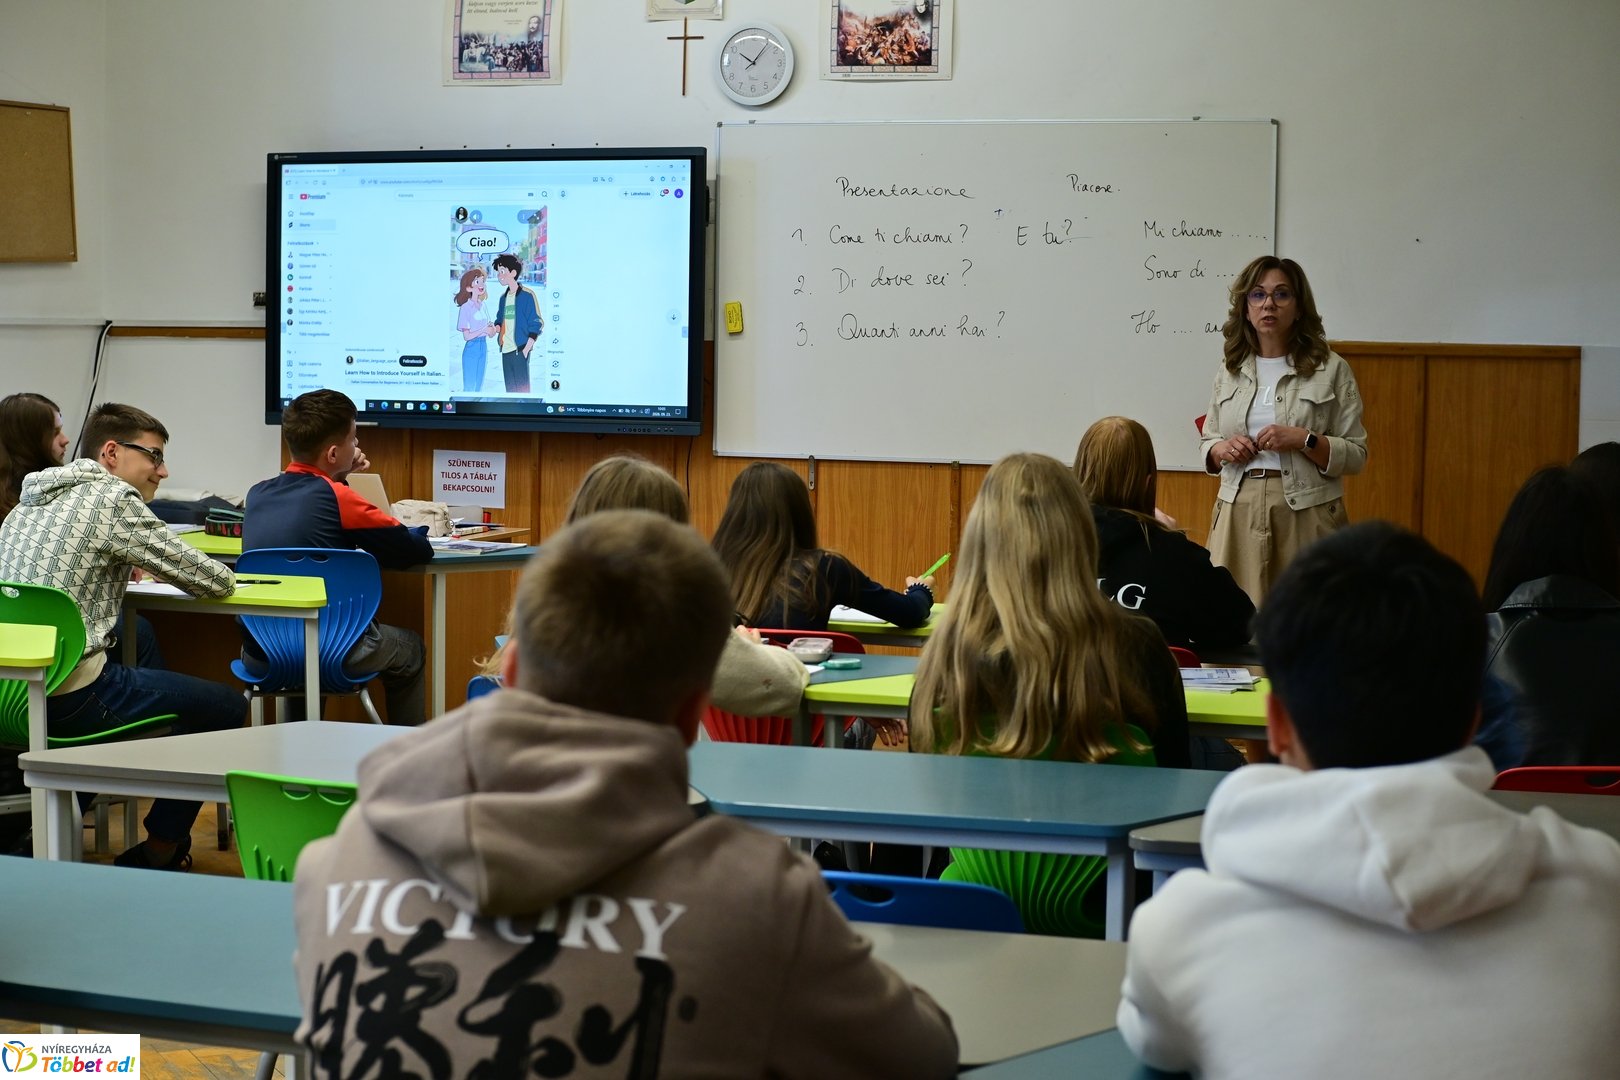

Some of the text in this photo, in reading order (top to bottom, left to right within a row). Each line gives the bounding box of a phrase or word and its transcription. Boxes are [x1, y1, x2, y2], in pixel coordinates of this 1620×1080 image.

[836, 176, 975, 199] Presentazione
[830, 224, 864, 244] Come
[1017, 226, 1029, 246] E
[1144, 221, 1165, 239] Mi
[1172, 220, 1223, 237] chiamo
[469, 237, 497, 247] Ciao!
[871, 266, 915, 287] dove
[1144, 255, 1182, 280] Sono
[1190, 260, 1207, 278] di
[837, 313, 900, 340] Quanti
[909, 324, 947, 337] anni
[1131, 310, 1160, 333] Ho
[1205, 322, 1224, 333] an
[448, 459, 490, 468] SZÜNETBEN
[470, 472, 497, 480] TÁBLÁT
[443, 484, 495, 493] BEKAPCSOLNI!
